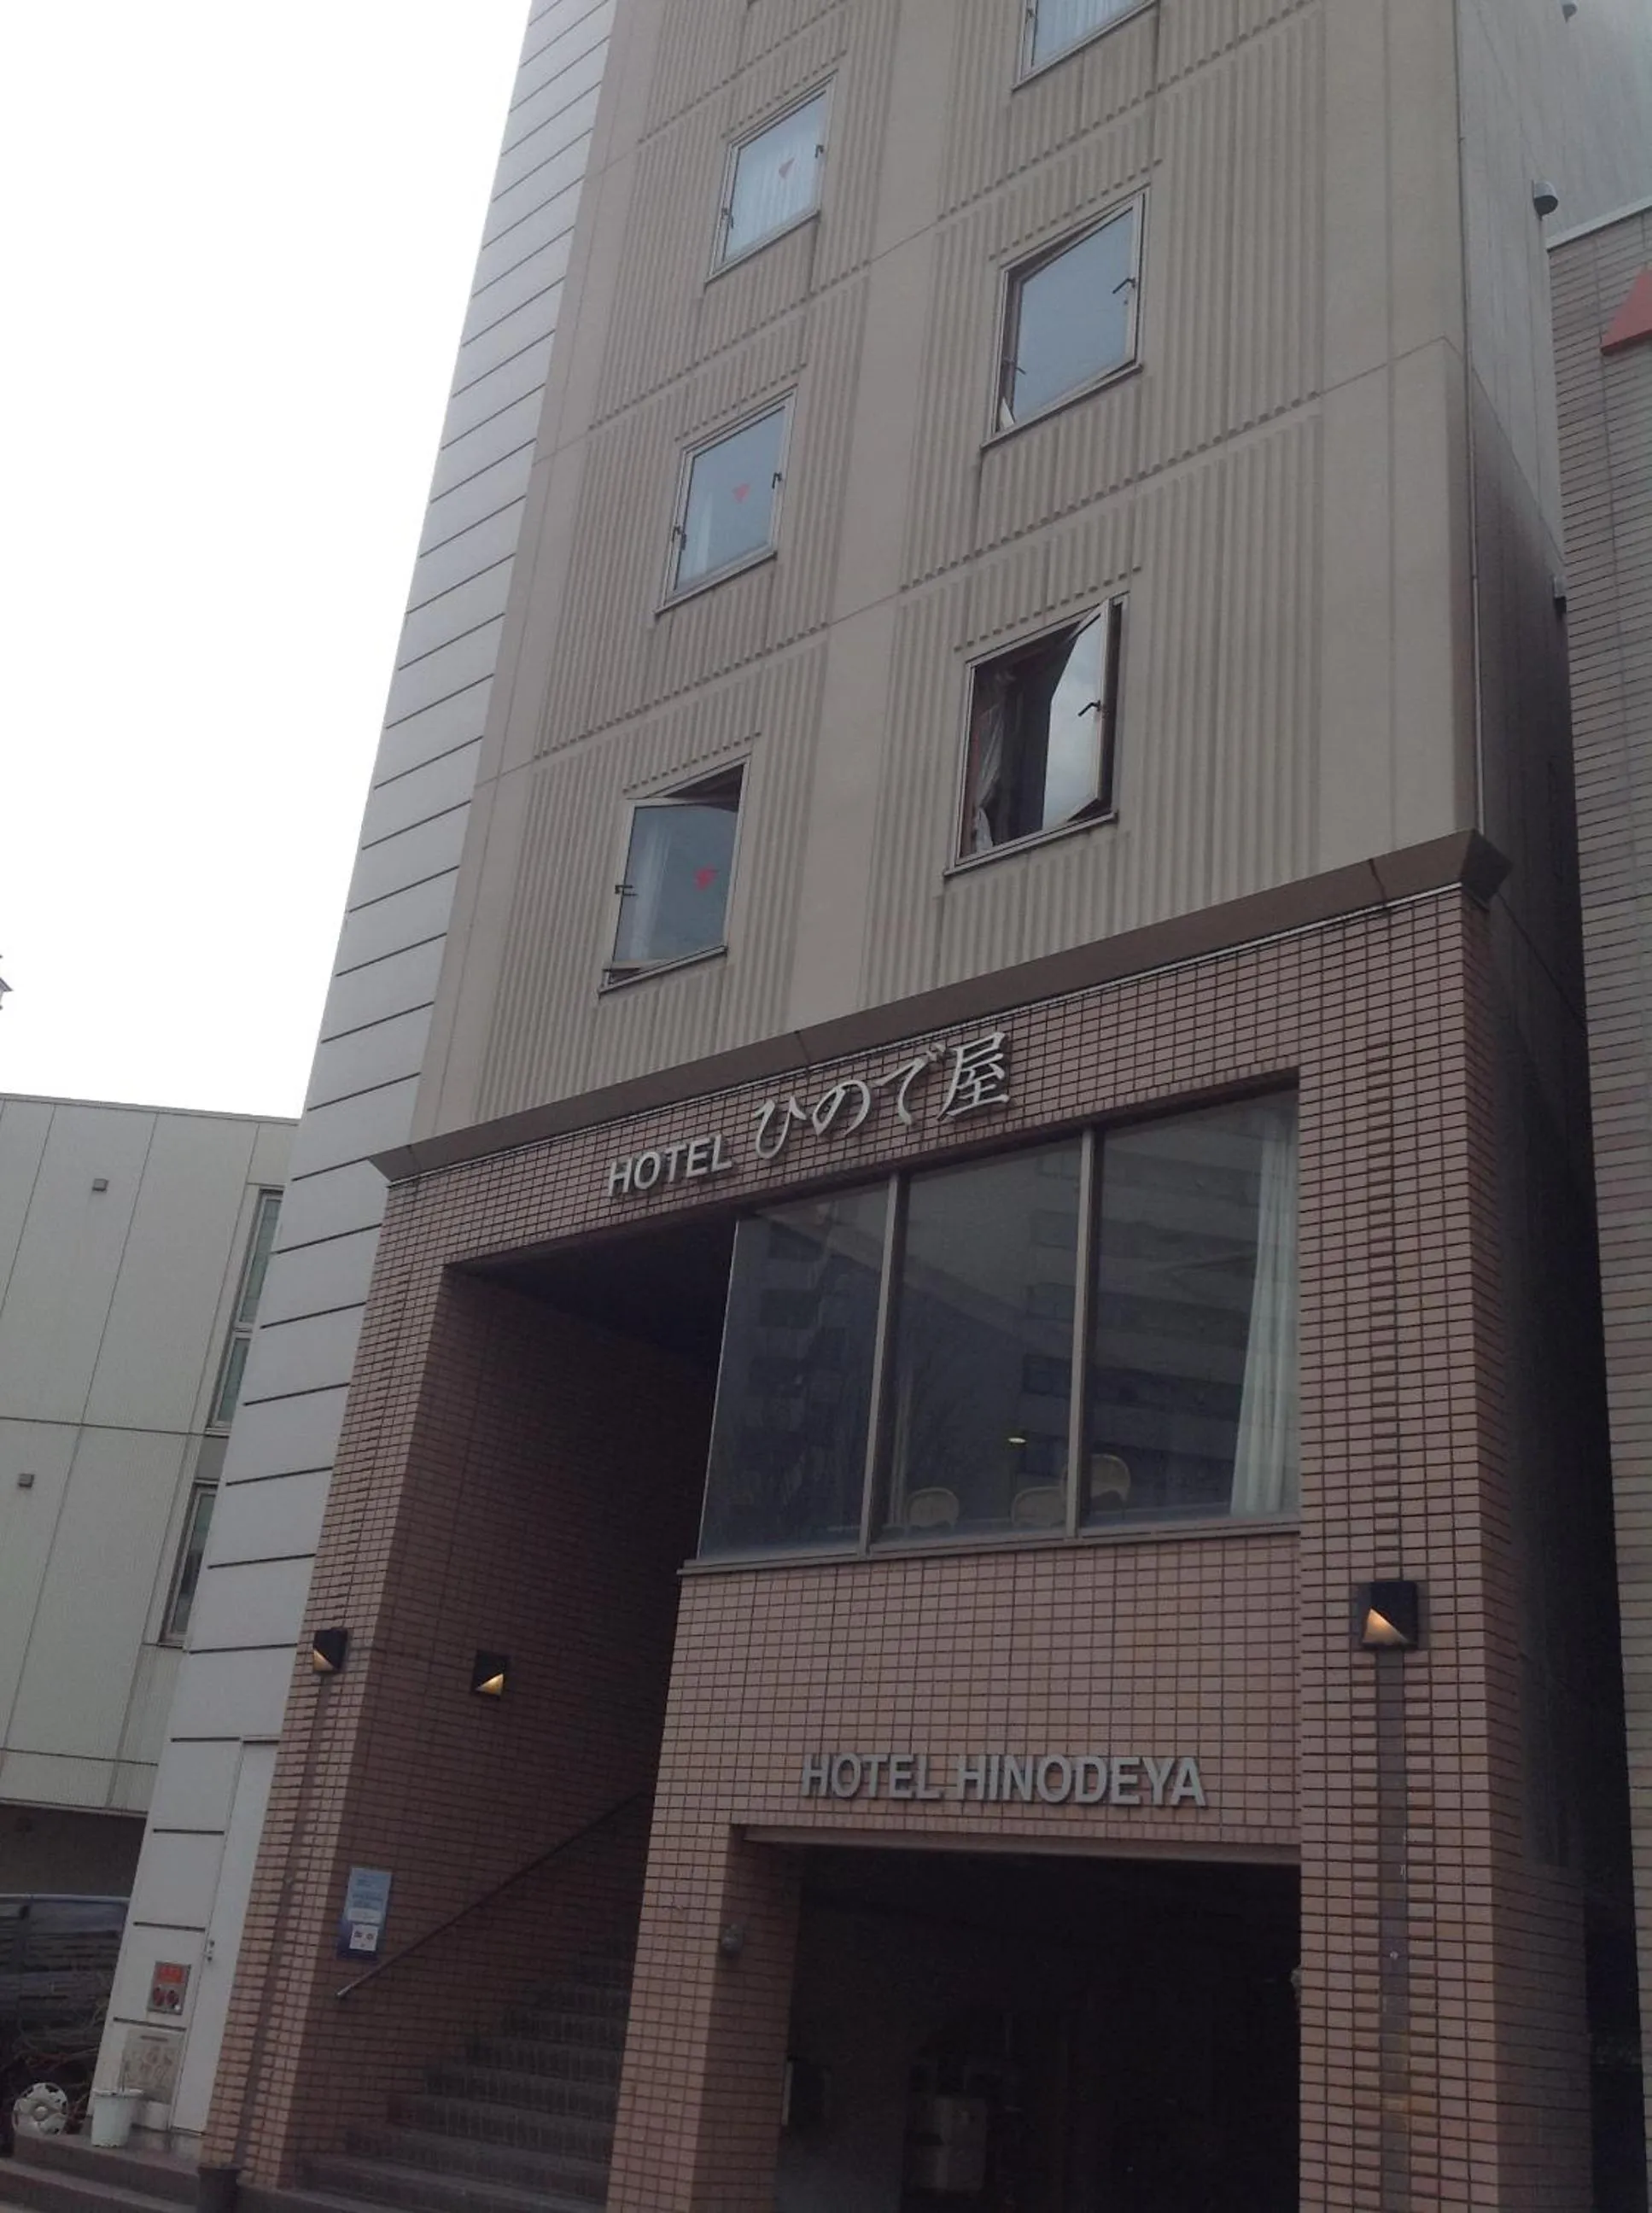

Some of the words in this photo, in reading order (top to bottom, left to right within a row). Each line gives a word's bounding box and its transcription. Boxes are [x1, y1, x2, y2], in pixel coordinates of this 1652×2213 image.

[607, 1133, 733, 1197] HOTEL
[752, 1031, 1011, 1159] ひので屋
[801, 1753, 943, 1800] HOTEL
[954, 1754, 1206, 1807] HINODEYA
